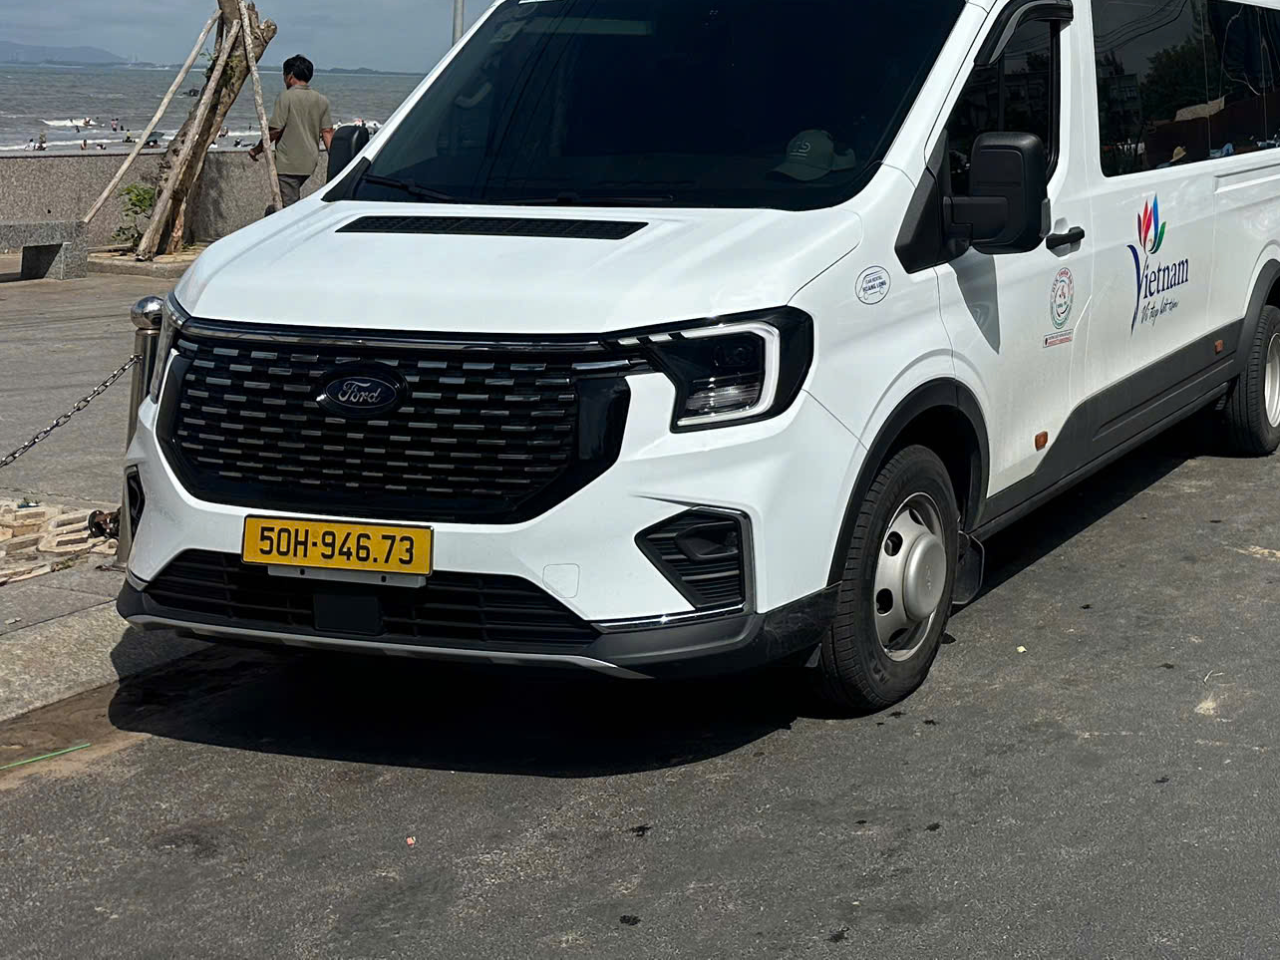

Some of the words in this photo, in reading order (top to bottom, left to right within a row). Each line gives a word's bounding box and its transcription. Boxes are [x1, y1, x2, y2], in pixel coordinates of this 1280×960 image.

[1127, 244, 1189, 337] Vietnam
[337, 381, 381, 403] Ford
[259, 525, 414, 565] 50H-946.73
